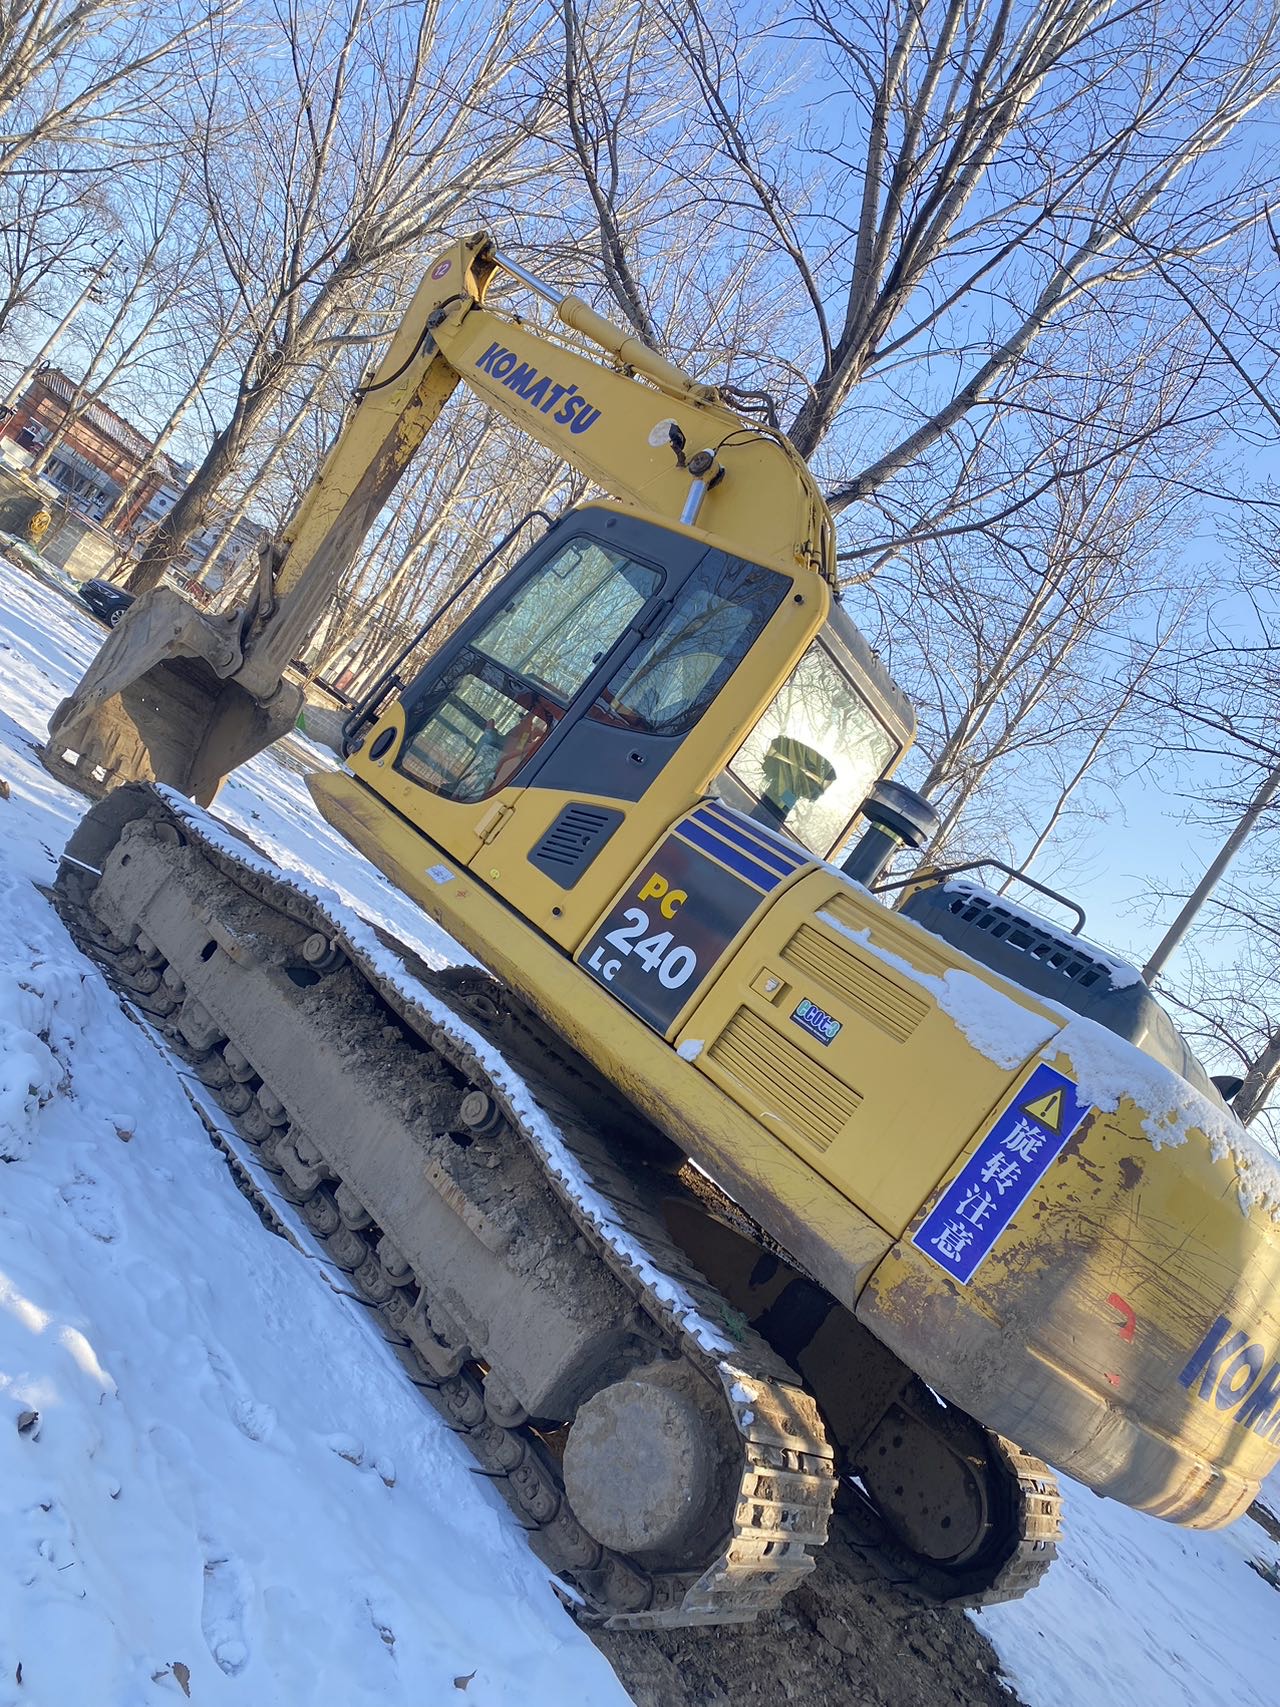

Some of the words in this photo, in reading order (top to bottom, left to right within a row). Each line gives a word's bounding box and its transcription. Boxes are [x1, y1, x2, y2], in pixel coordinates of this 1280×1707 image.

[475, 342, 602, 434] KOMATSU
[637, 872, 688, 920] PC
[587, 946, 622, 981] LC
[605, 907, 697, 990] 240
[931, 1117, 1047, 1263] 旋转注意
